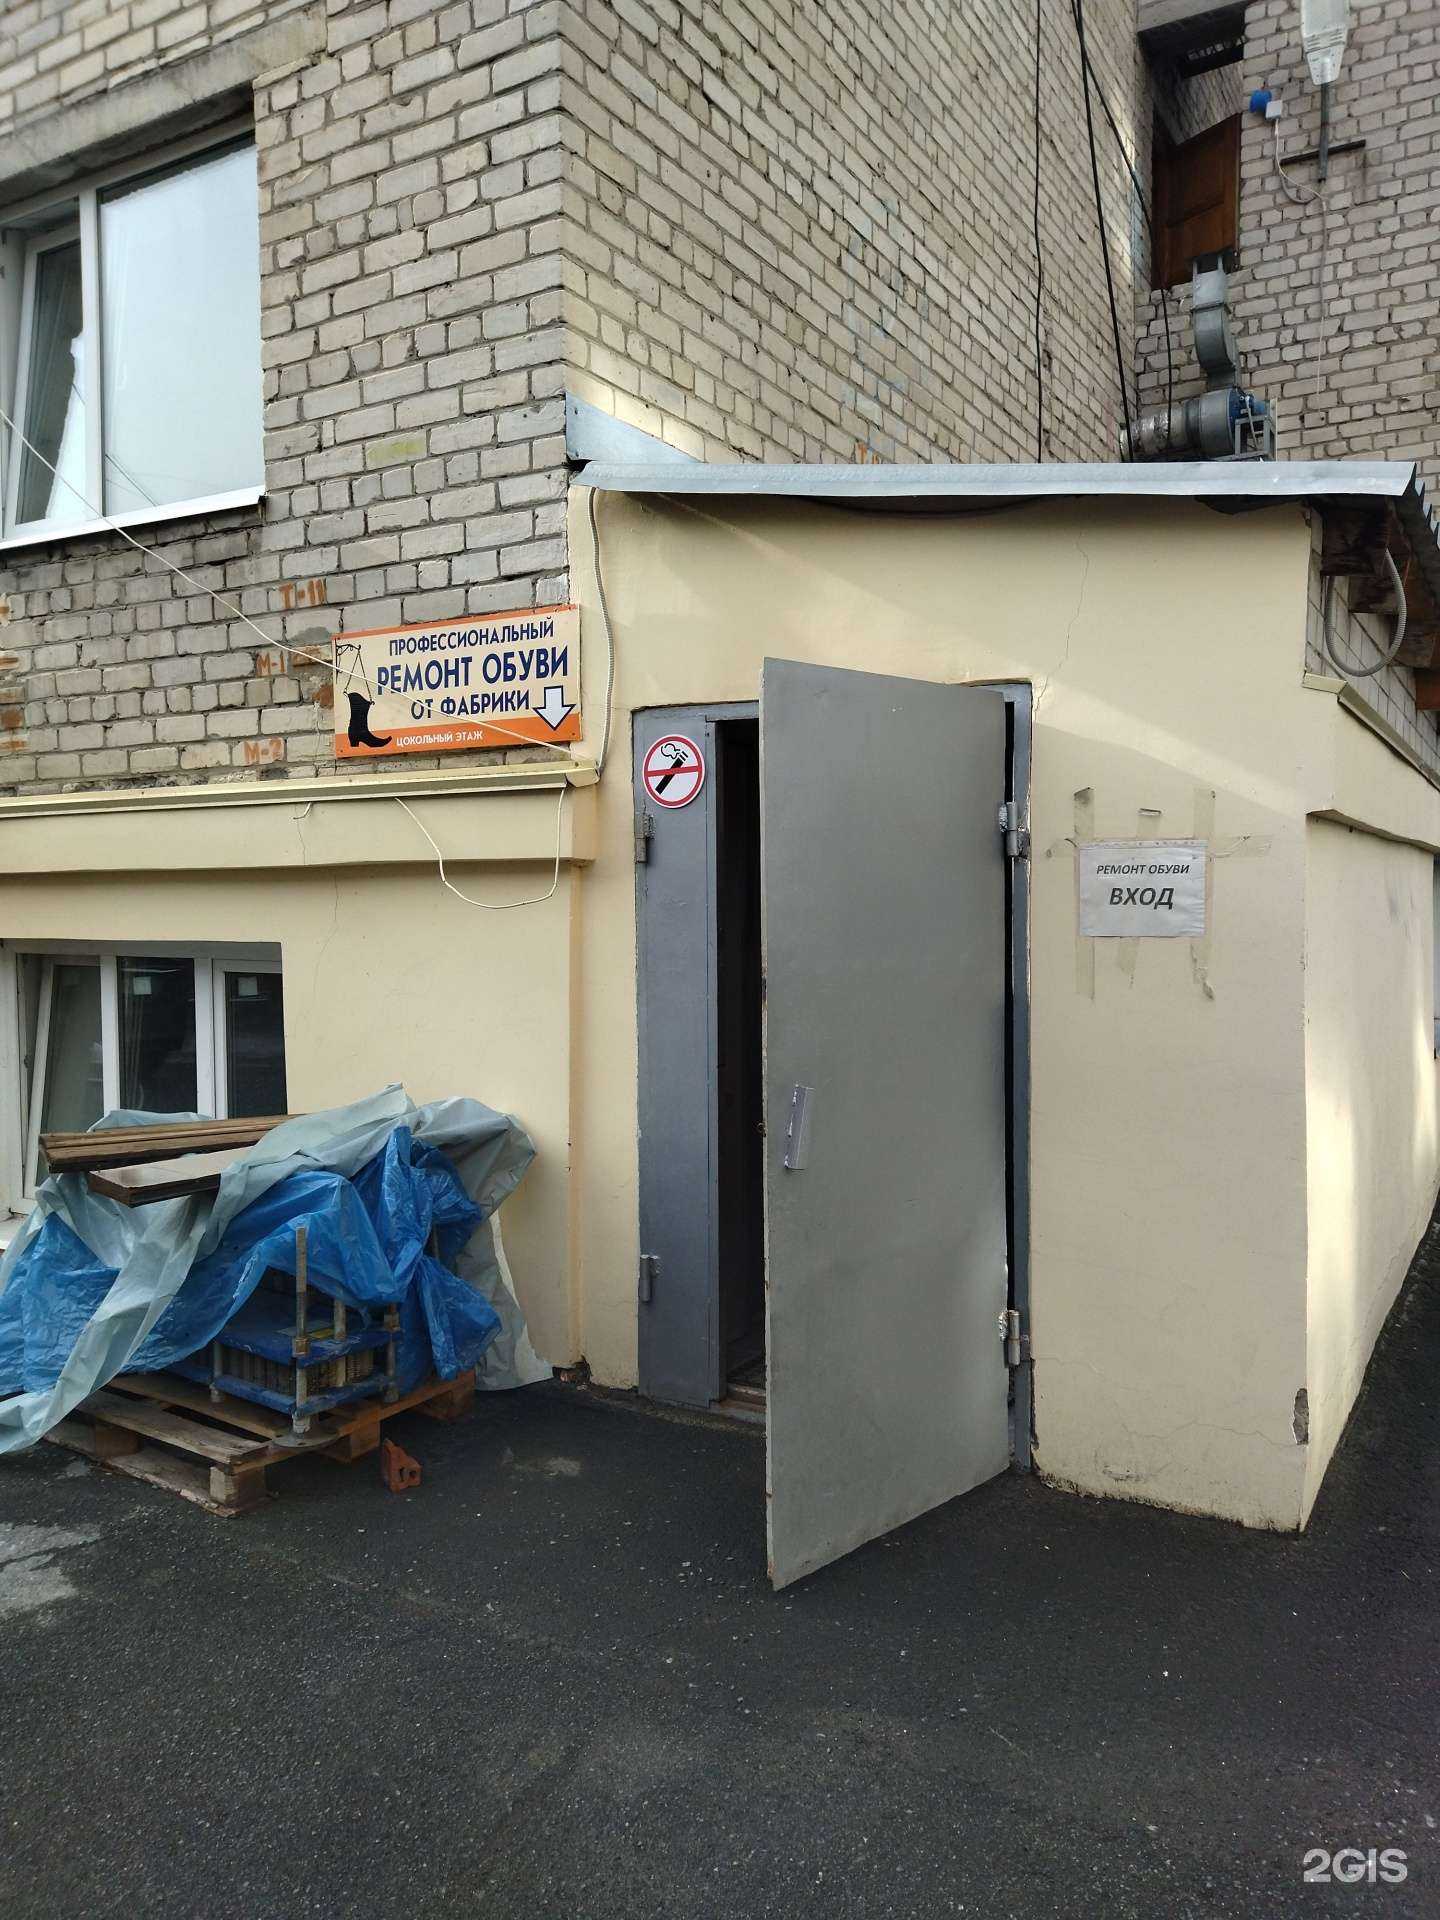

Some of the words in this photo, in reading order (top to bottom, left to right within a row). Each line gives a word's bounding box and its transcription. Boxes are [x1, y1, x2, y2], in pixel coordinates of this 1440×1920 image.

[389, 616, 554, 656] ПРОФЕССИОНАЛЬНЫЙ
[377, 656, 472, 695] РЕМОНТ
[482, 645, 568, 684] ОБУВИ
[411, 698, 434, 720] ОТ
[441, 689, 530, 717] ФАБРИКИ
[396, 733, 453, 747] ЦОКОЛЬНЫЙ
[456, 730, 483, 742] ЭТАЖ
[1096, 864, 1146, 875] РЕМОНТ
[1148, 864, 1190, 875] ОБУВИ
[1109, 887, 1175, 910] ВХОД
